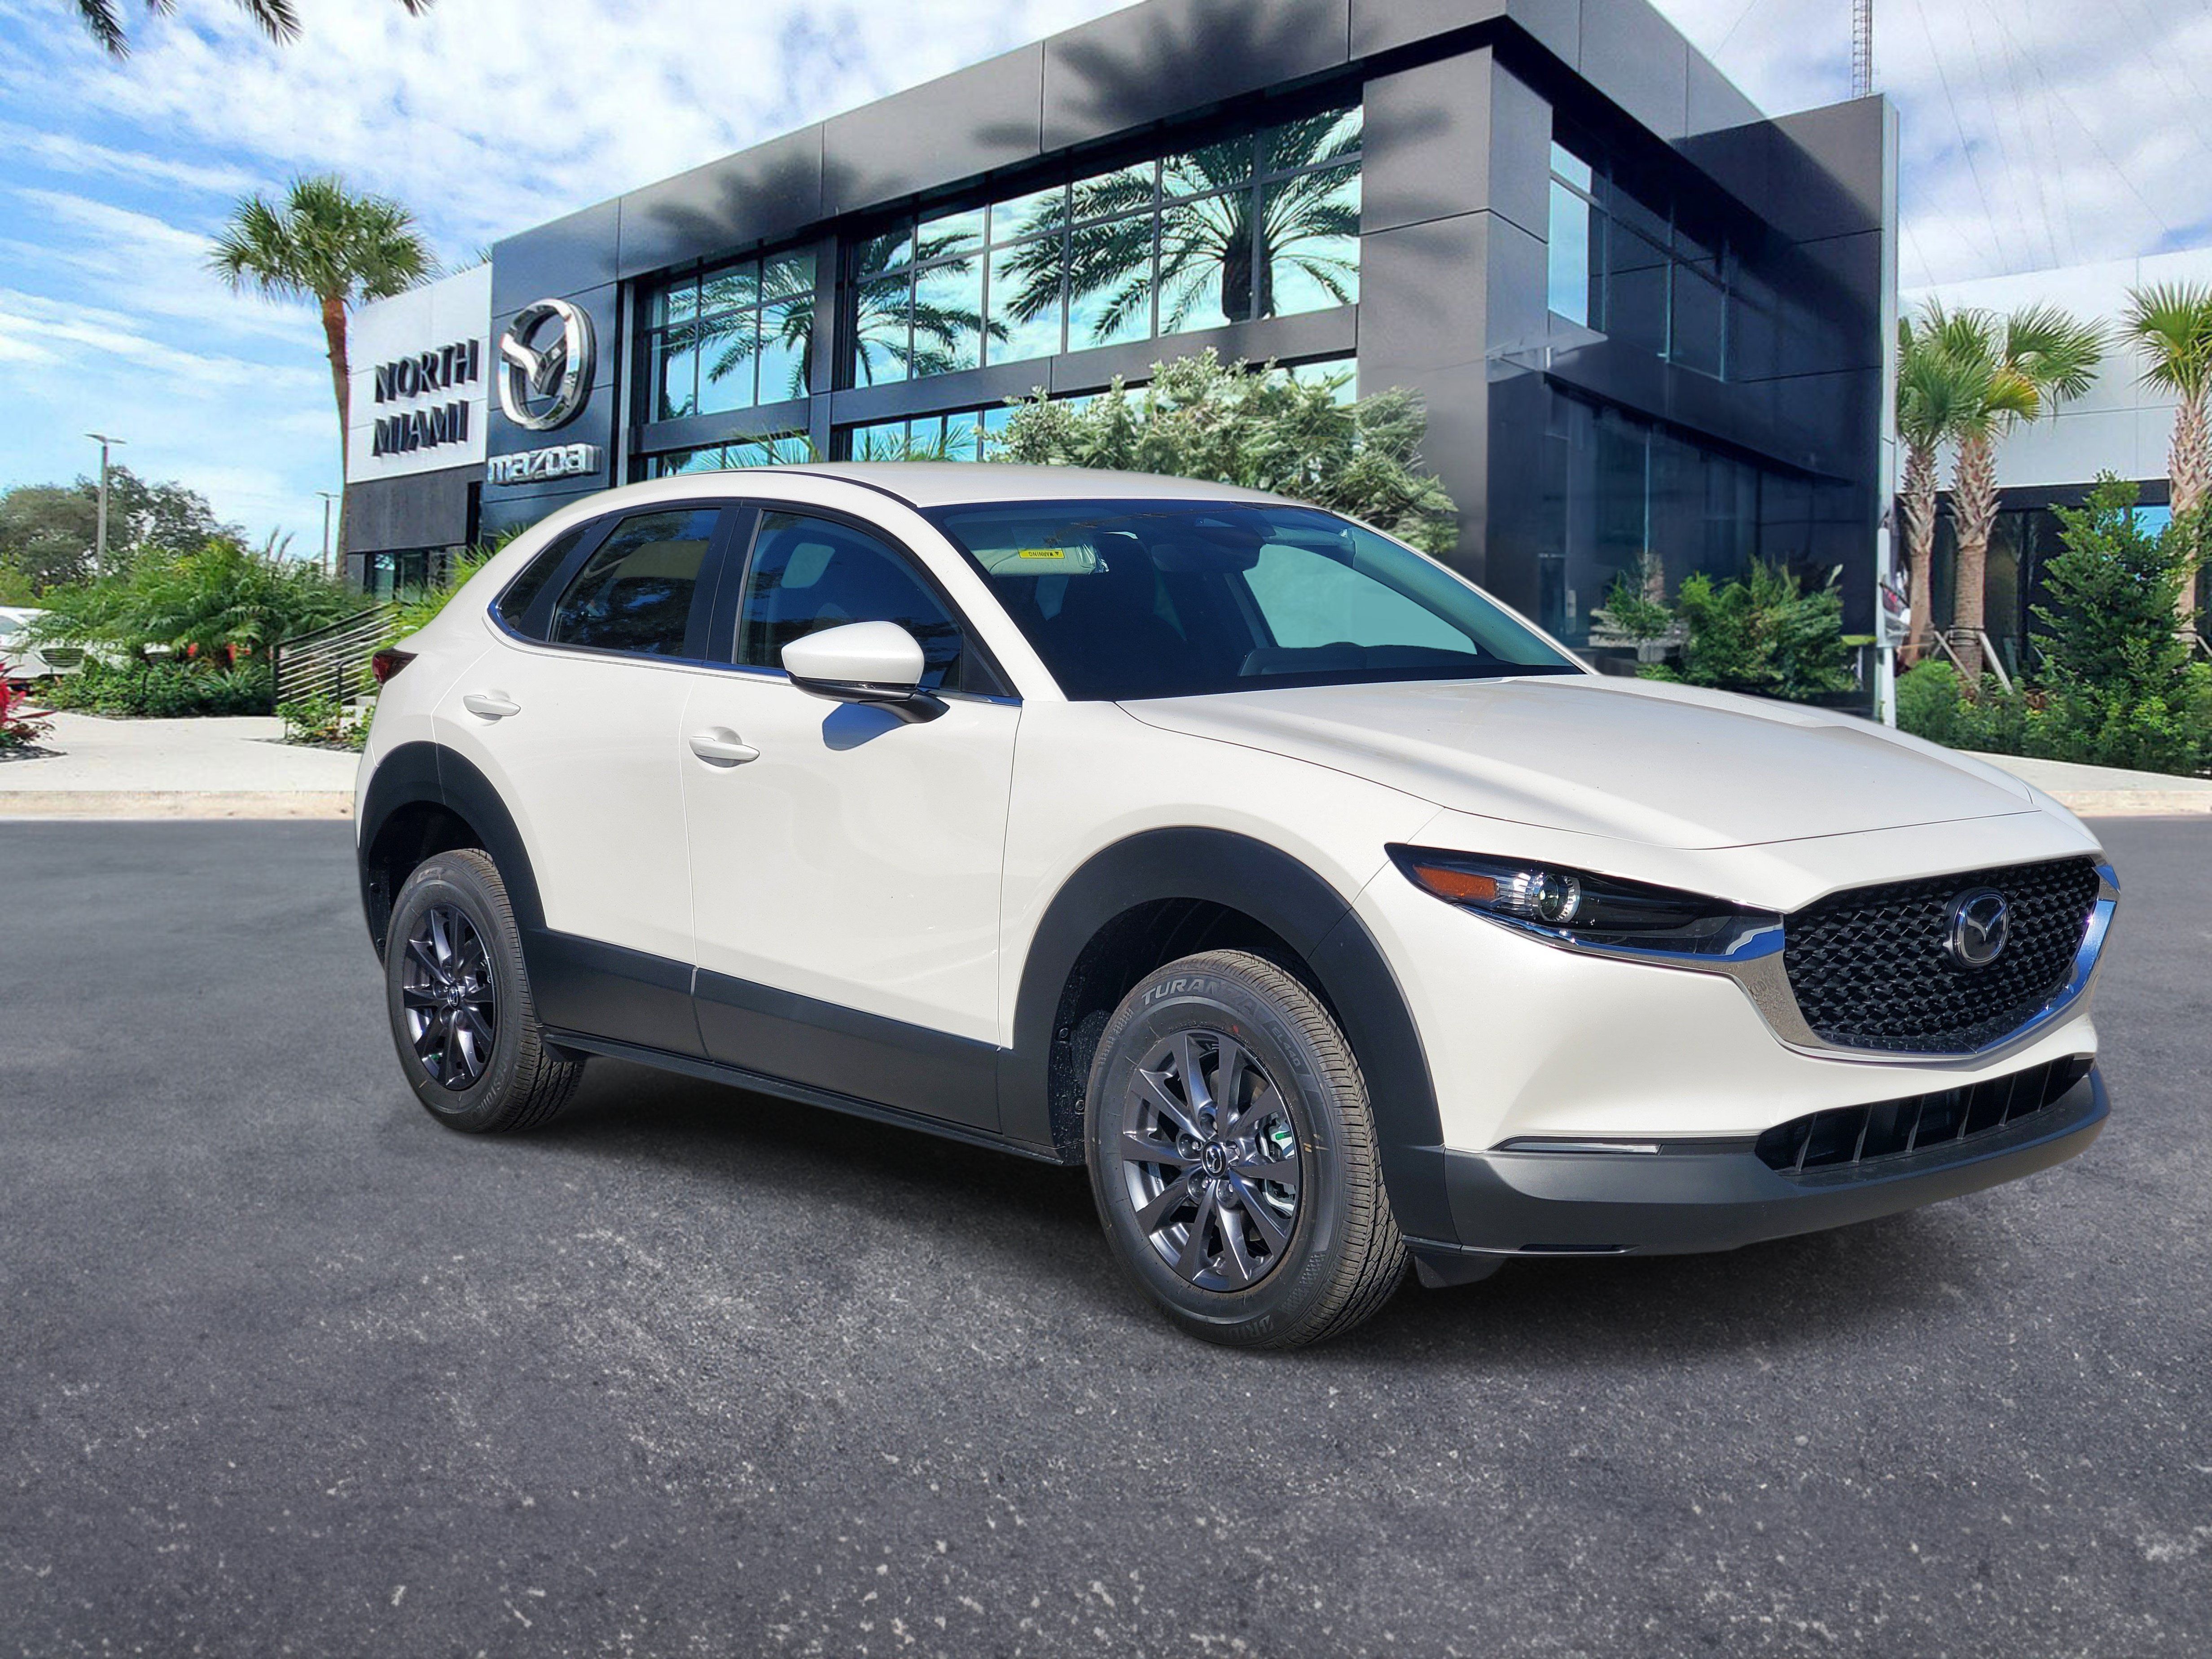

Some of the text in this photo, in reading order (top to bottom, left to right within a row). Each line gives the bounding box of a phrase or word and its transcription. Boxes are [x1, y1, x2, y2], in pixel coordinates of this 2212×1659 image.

[375, 338, 479, 404] NORTH
[372, 399, 469, 456] MIAMI
[487, 443, 598, 483] mazda
